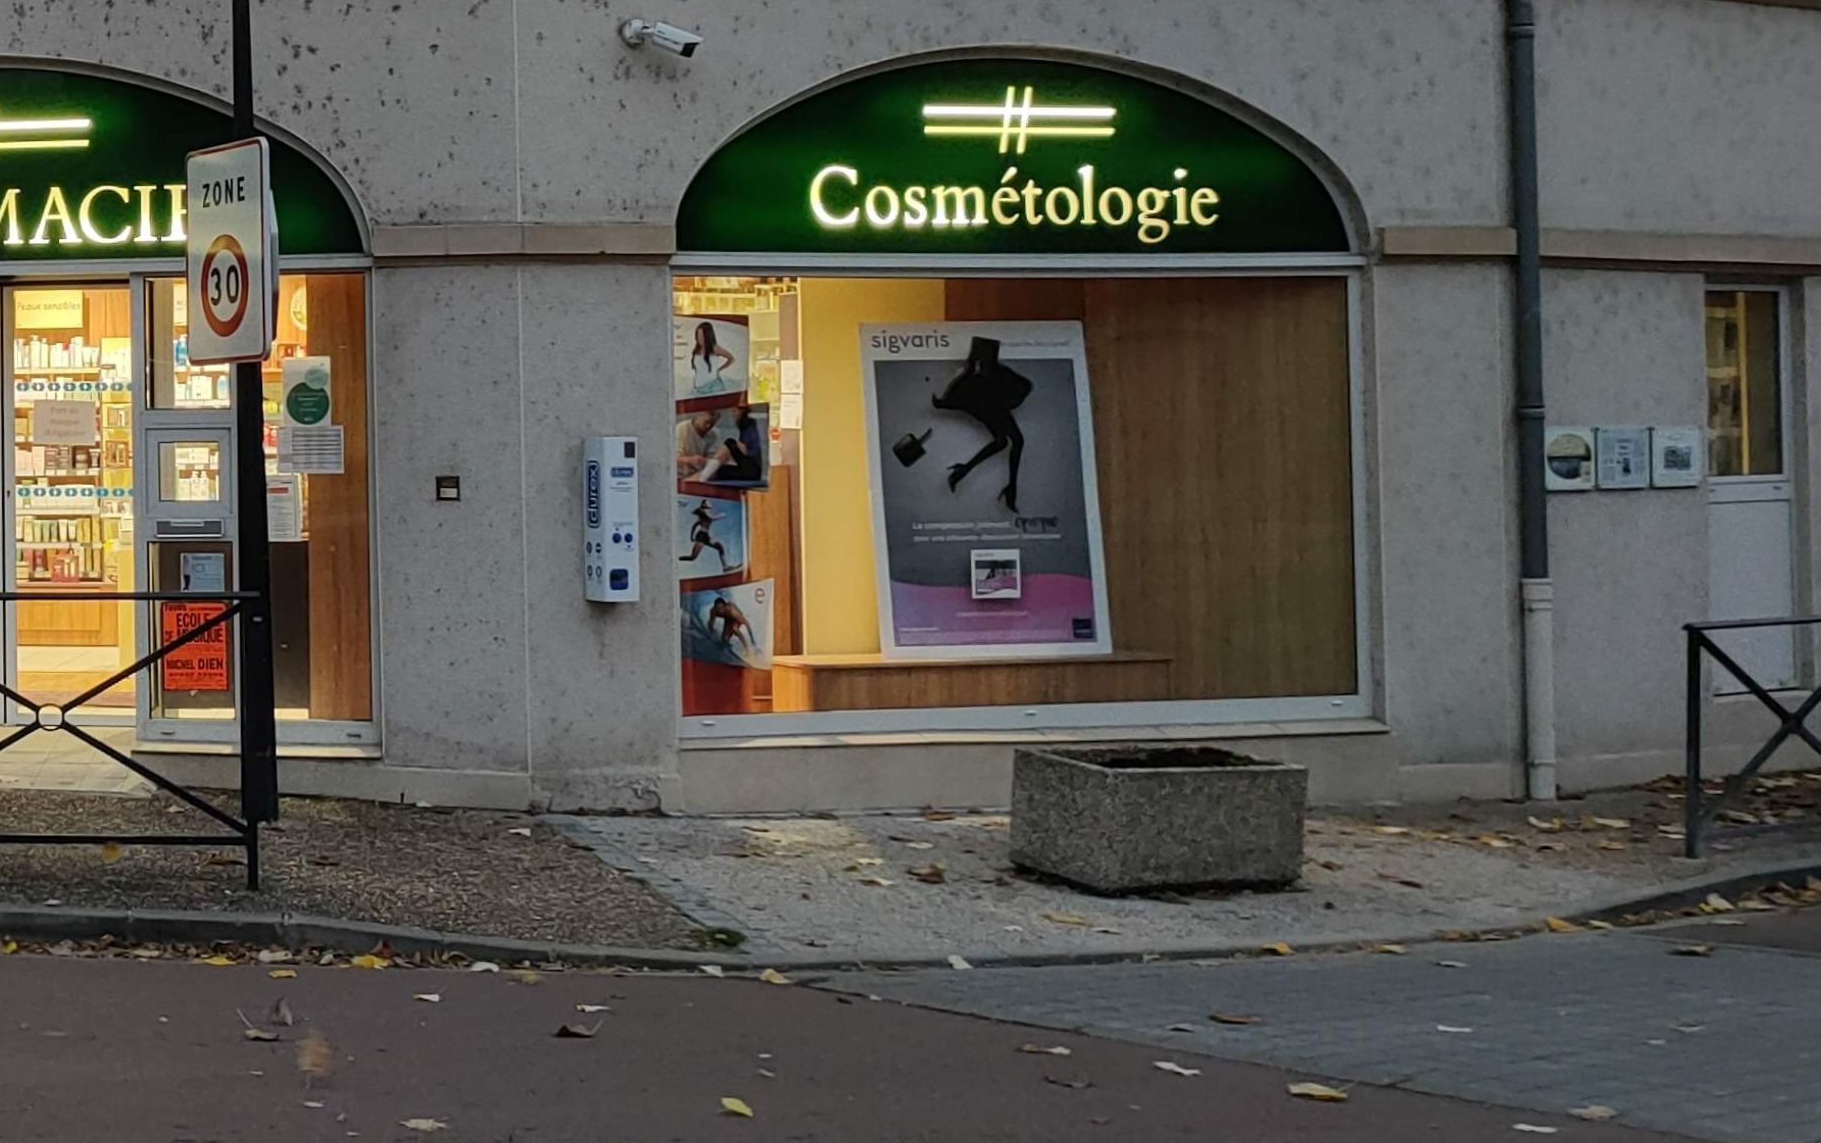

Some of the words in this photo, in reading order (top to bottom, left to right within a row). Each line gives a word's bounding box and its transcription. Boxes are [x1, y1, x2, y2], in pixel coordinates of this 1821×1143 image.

[201, 176, 246, 208] ZONE
[809, 164, 1219, 244] Cosmétologie
[209, 264, 241, 307] 30
[871, 329, 951, 354] sigvaris
[587, 463, 600, 525] durex
